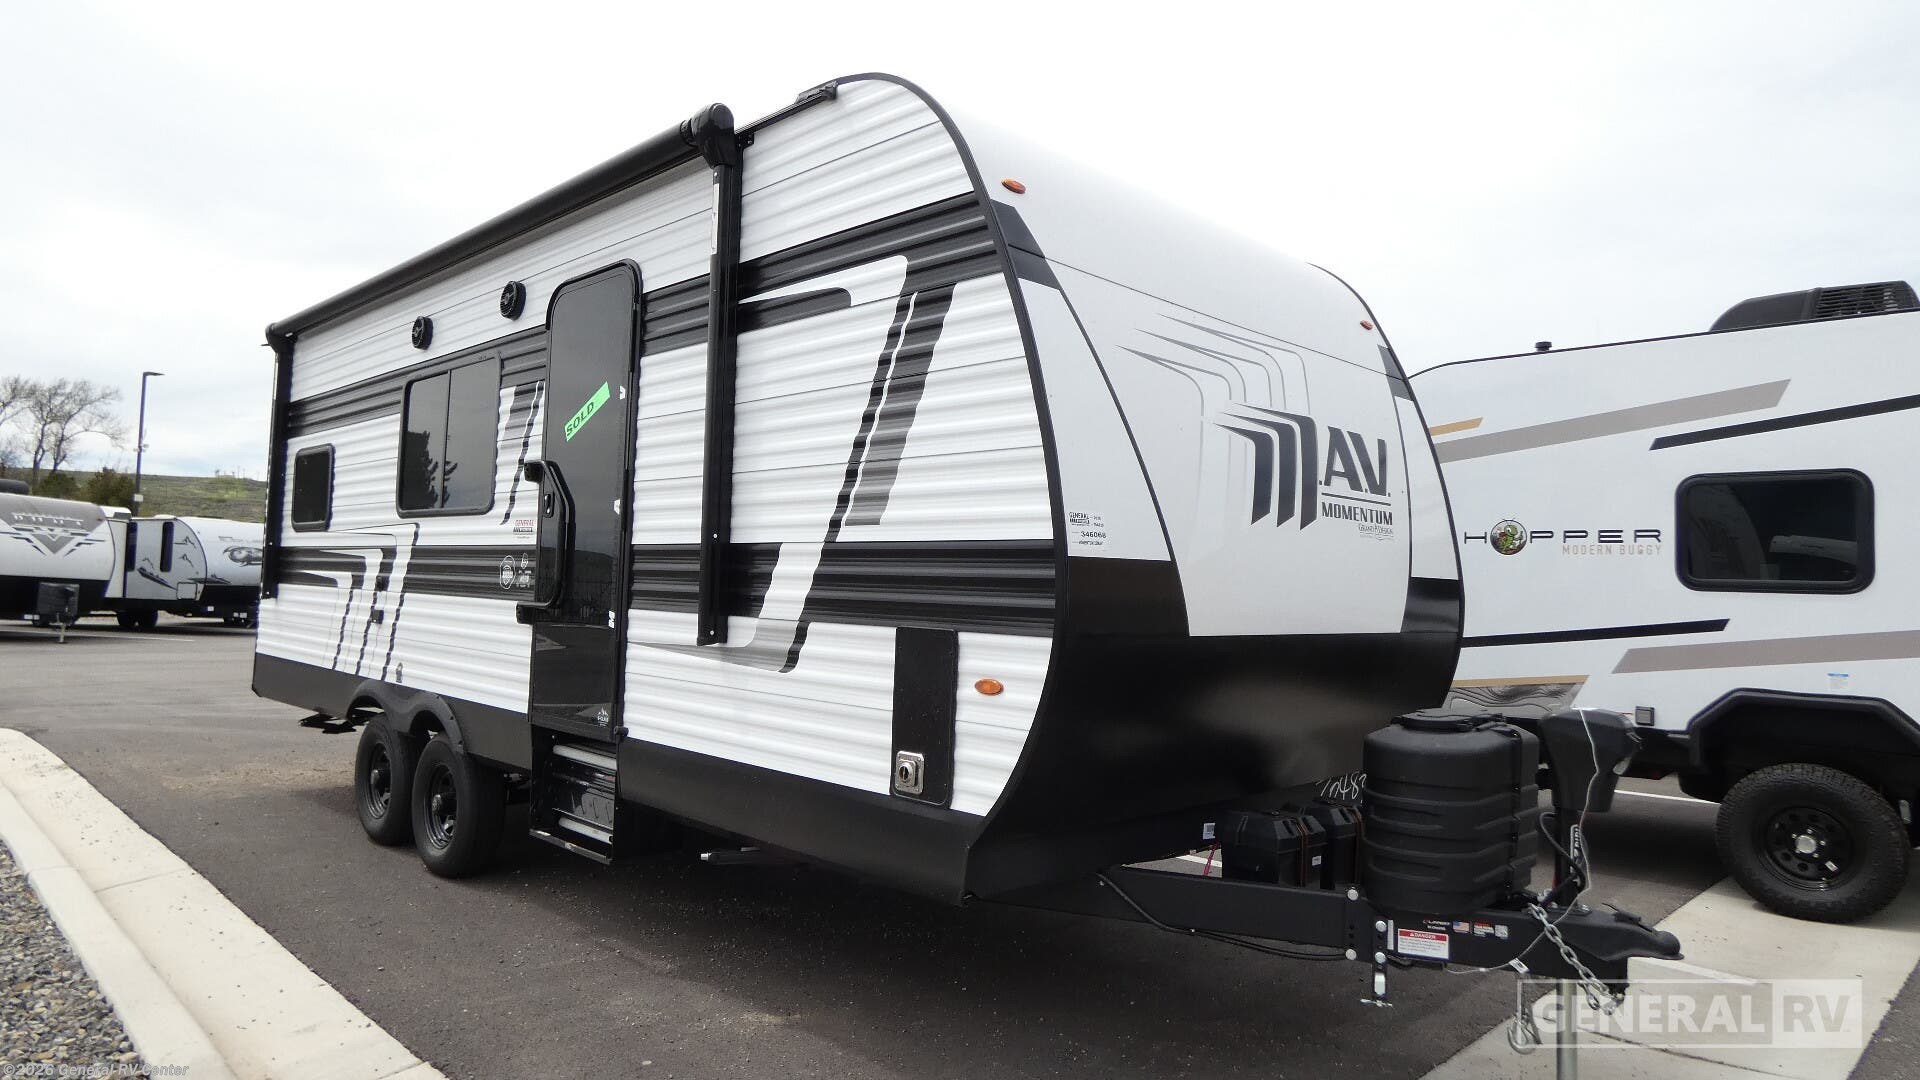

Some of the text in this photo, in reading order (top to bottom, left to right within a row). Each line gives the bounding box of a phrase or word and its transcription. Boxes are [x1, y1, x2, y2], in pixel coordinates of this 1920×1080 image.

[566, 401, 595, 437] SOLD
[1321, 501, 1393, 526] MOMENTUM
[1562, 544, 1662, 556] MODERN BUGGY
[1414, 932, 1436, 940] DANGER
